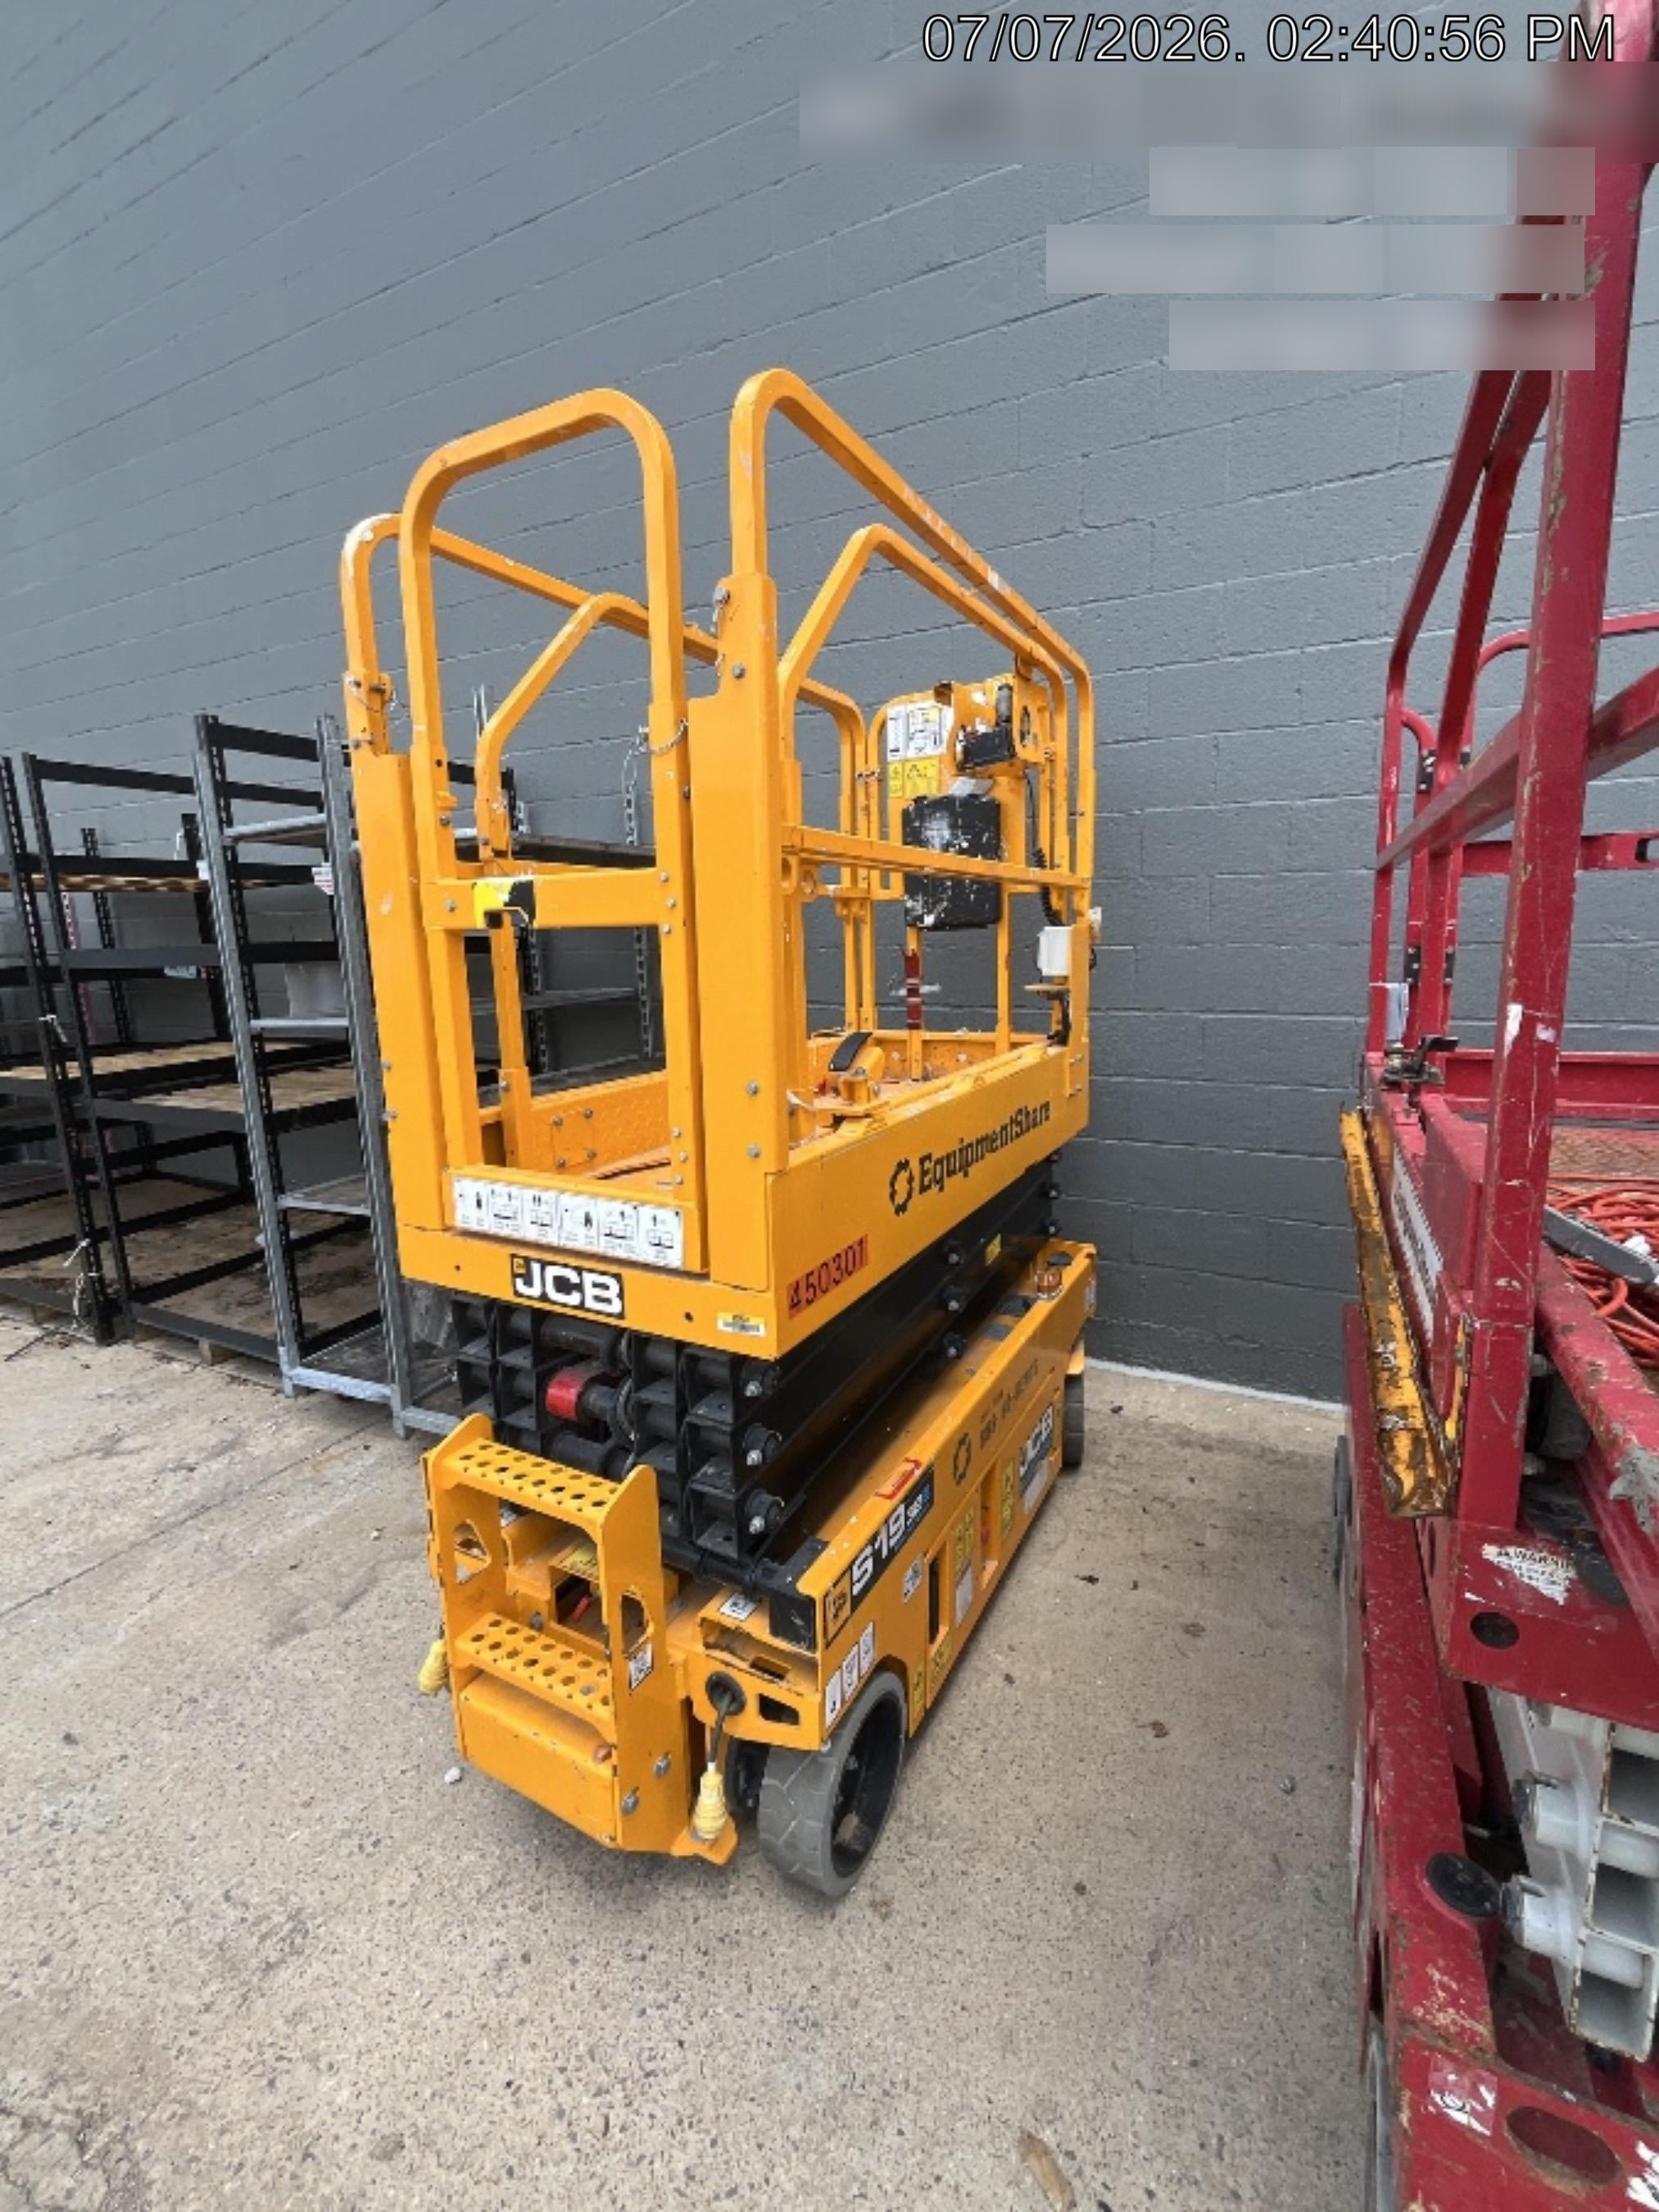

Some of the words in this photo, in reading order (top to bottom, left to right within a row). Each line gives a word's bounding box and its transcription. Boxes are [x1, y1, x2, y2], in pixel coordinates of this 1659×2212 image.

[918, 1100, 1051, 1195] EquipmentShare
[514, 1260, 623, 1314] JCB
[789, 1236, 864, 1309] 450301
